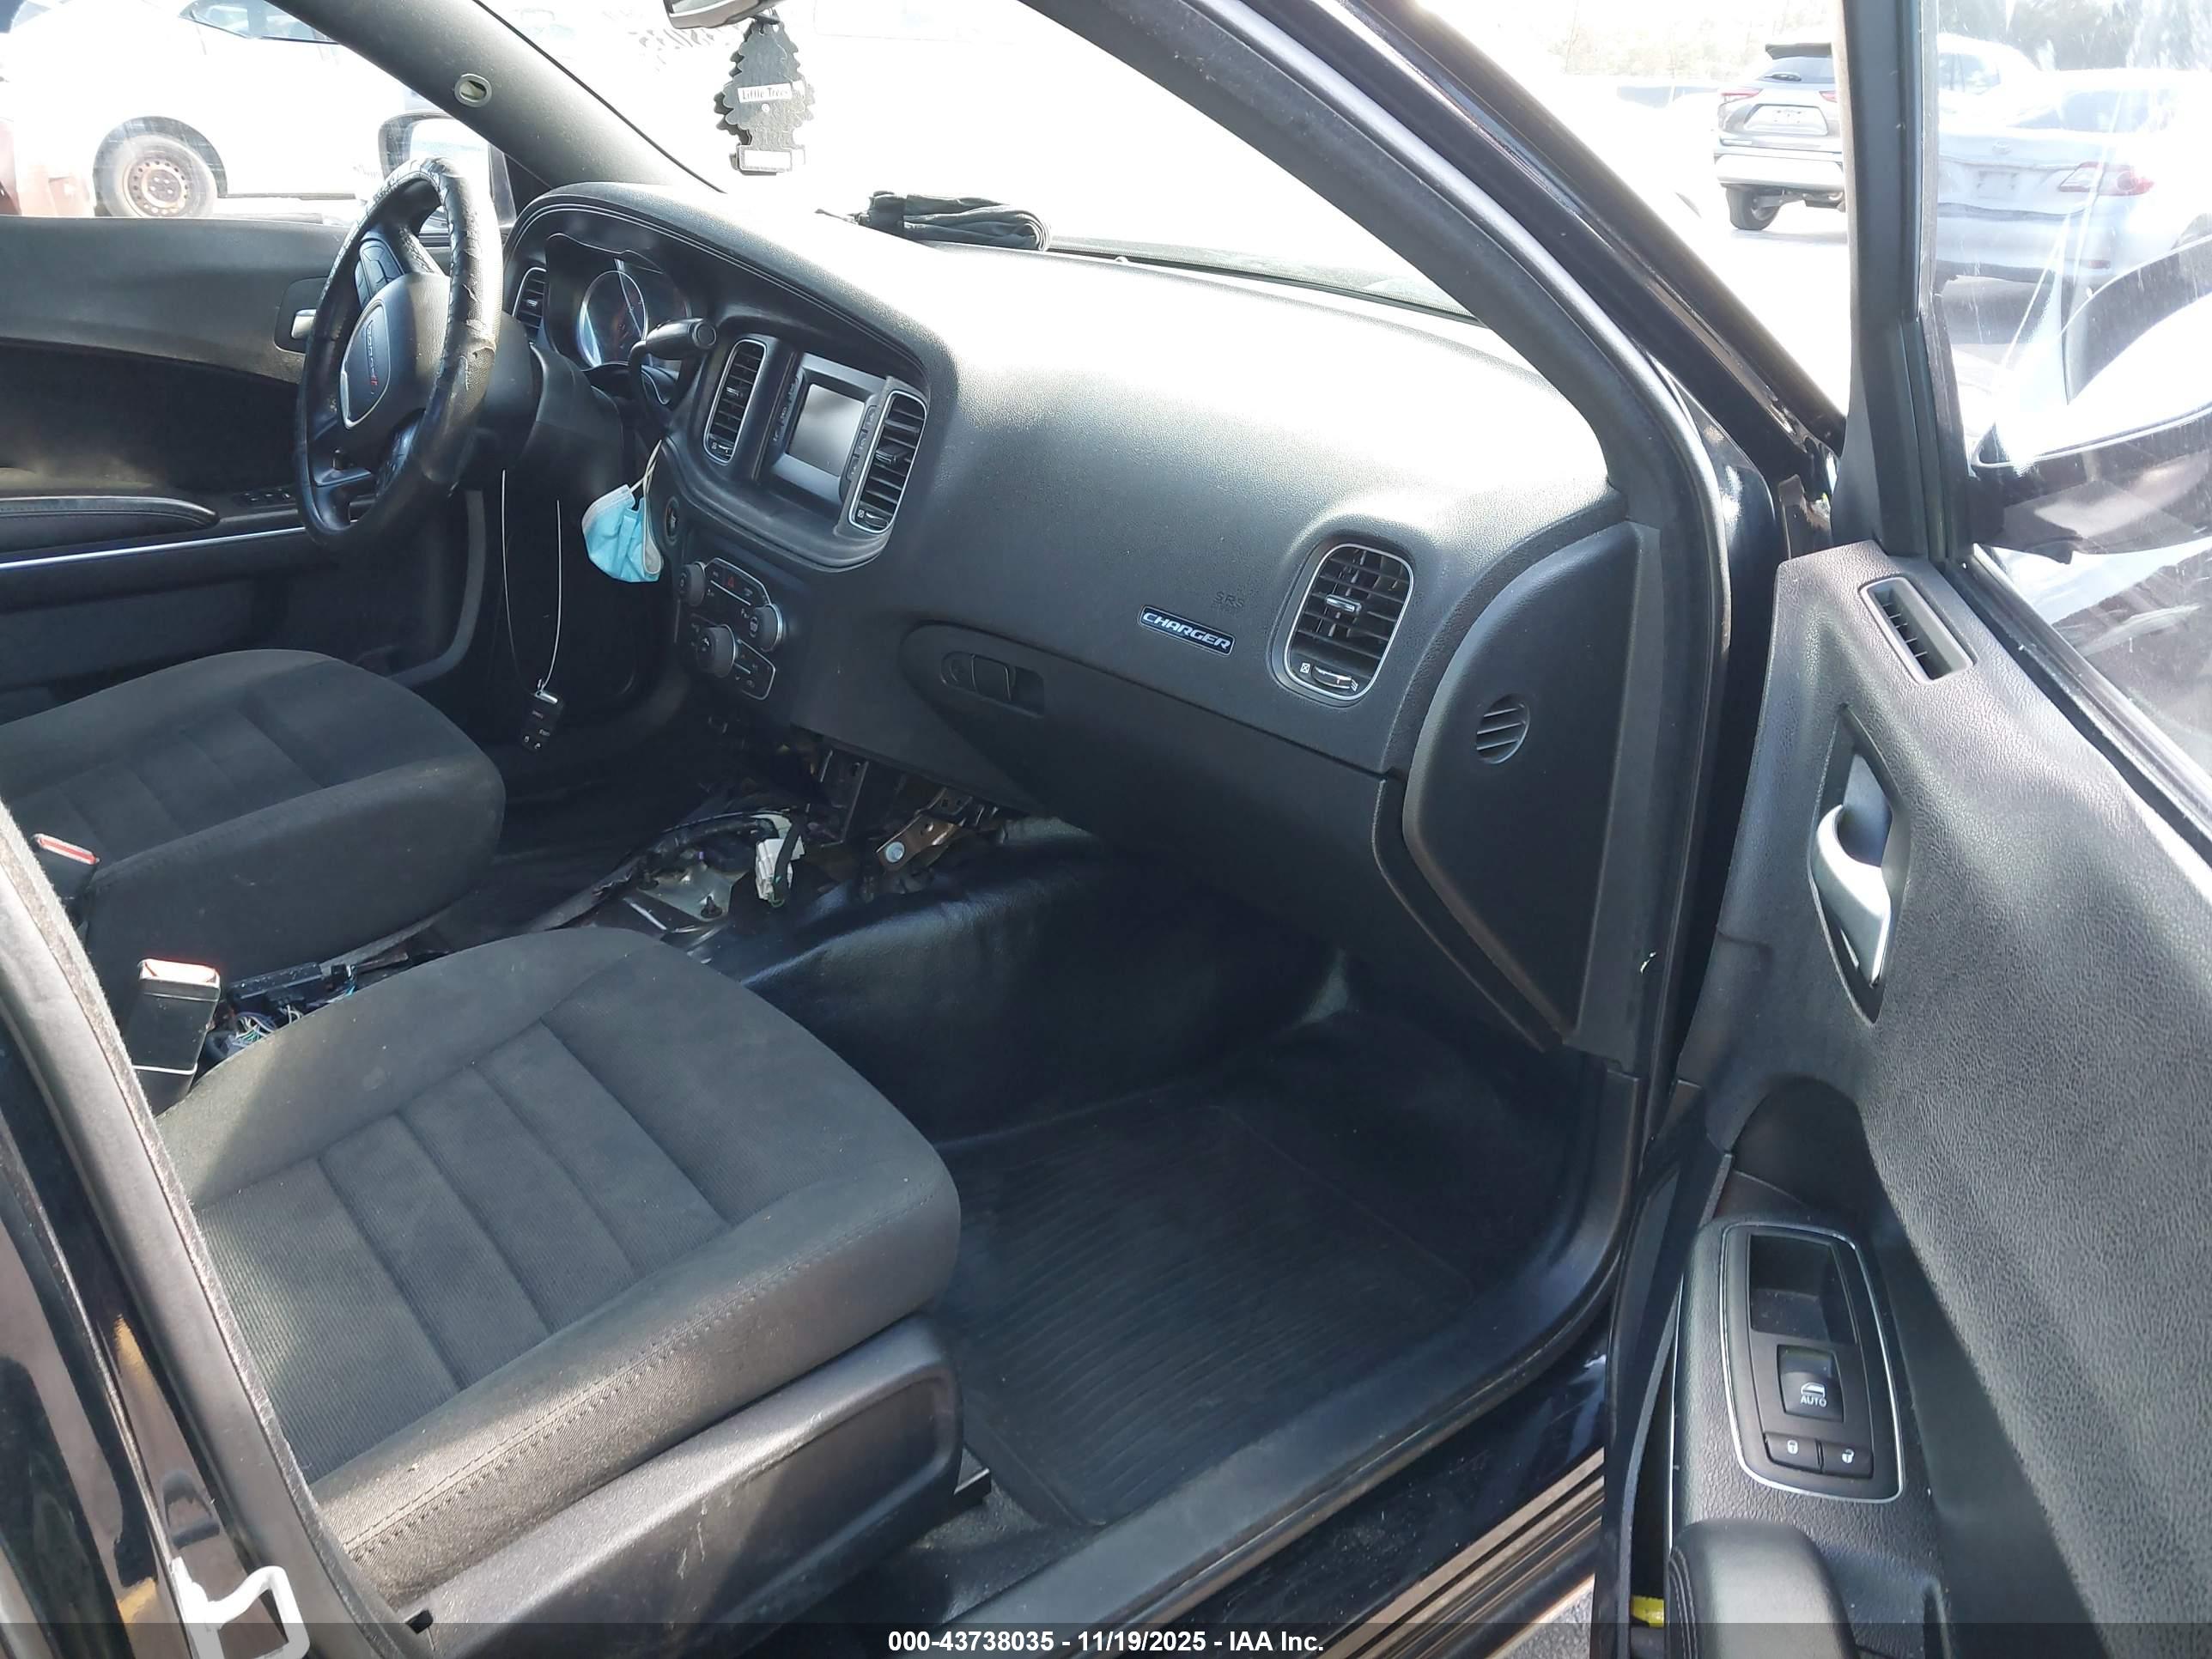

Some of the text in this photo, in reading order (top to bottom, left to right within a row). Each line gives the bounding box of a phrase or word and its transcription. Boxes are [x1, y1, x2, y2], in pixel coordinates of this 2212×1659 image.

[742, 88, 763, 100] Little
[1143, 612, 1231, 650] CHARGER
[1801, 1395, 1827, 1407] AUTO
